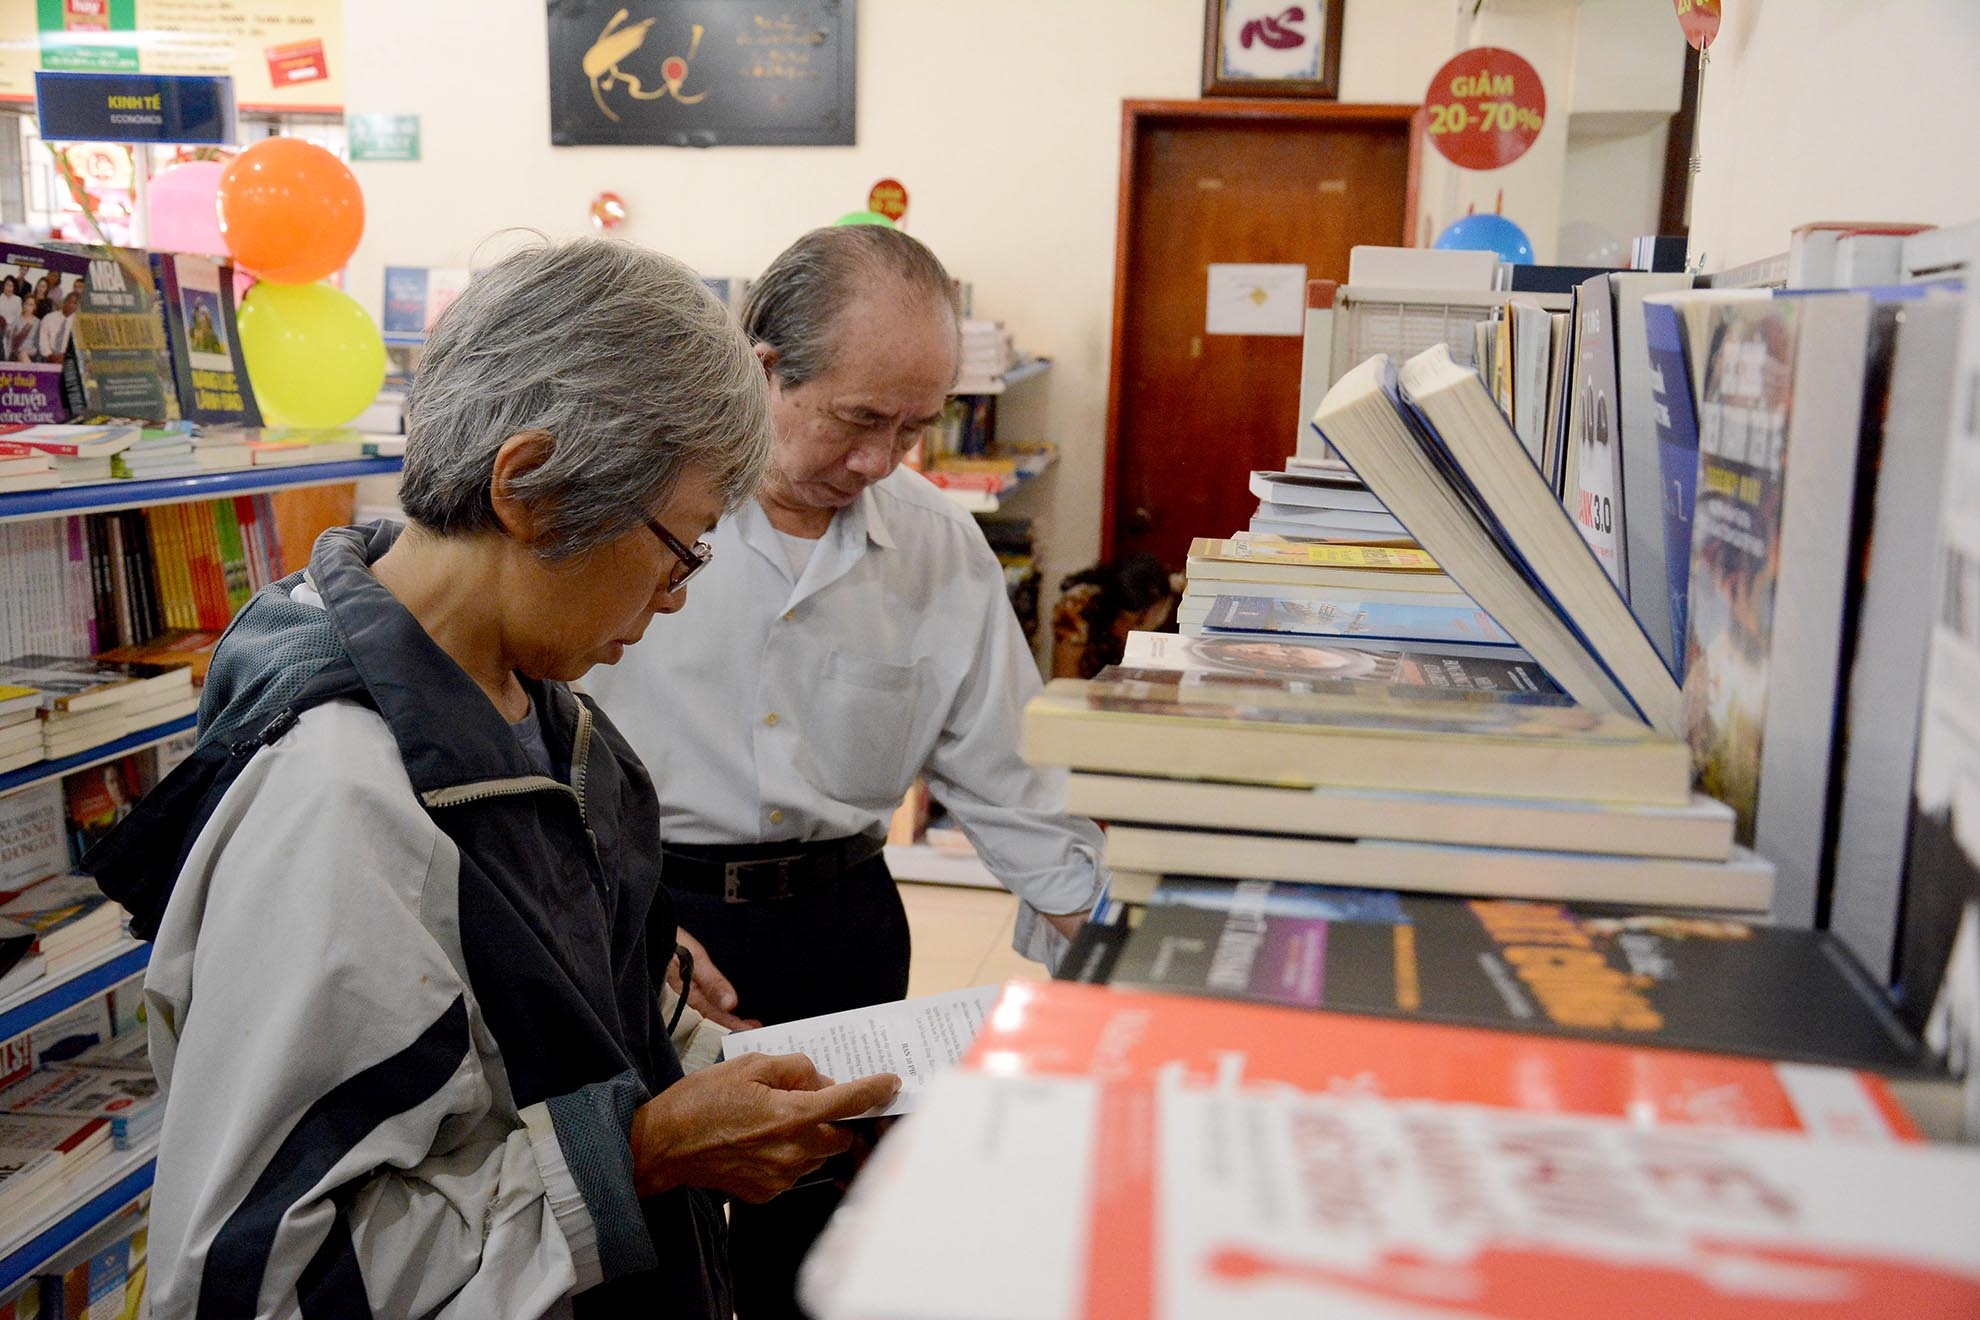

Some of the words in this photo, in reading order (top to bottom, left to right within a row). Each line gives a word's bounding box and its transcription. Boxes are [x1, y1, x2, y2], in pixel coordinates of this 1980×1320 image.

[1450, 70, 1514, 98] GIẢM
[108, 95, 143, 109] KINH
[111, 115, 162, 124] ECONOMICS
[1429, 102, 1542, 133] 20-70%
[89, 260, 127, 292] MBA
[1595, 495, 1611, 534] 3.0
